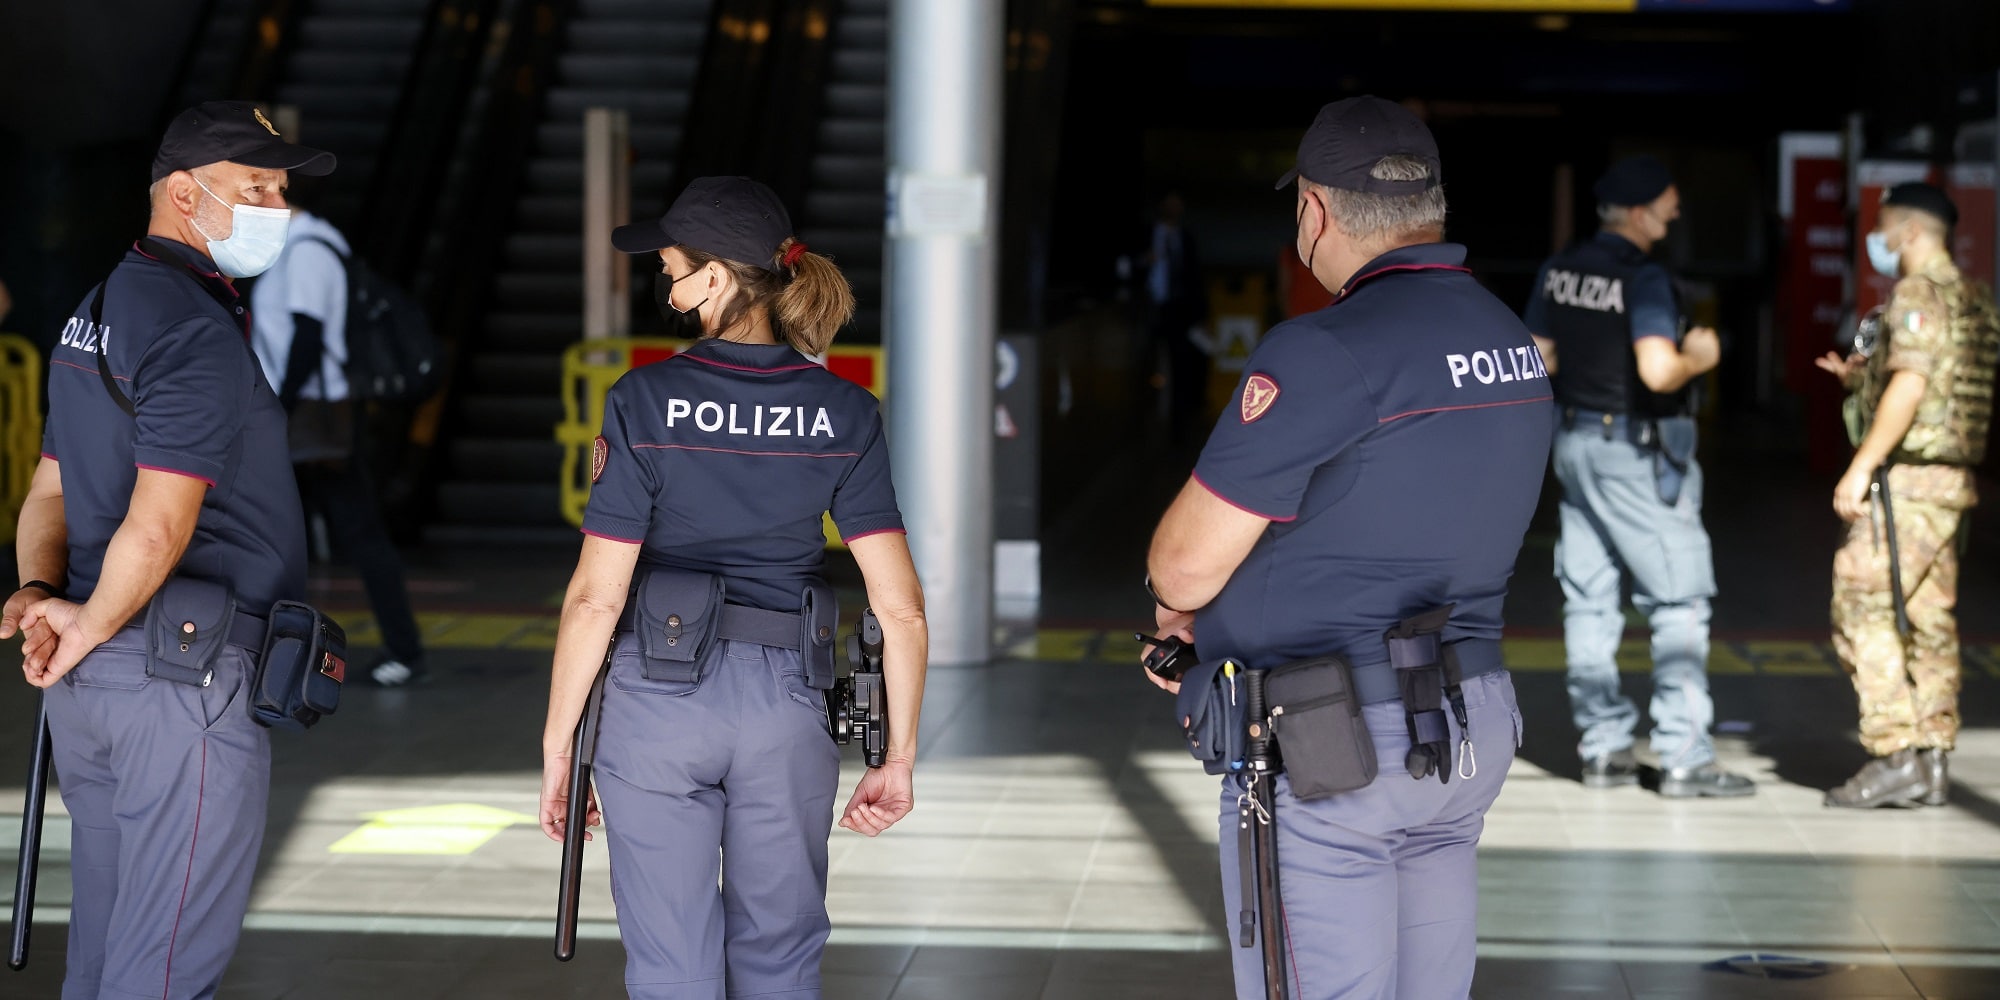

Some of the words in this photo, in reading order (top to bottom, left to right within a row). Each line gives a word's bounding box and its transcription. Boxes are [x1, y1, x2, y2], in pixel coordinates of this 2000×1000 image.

[1543, 268, 1625, 314] POLIZIA
[61, 316, 110, 355] OLIZA
[1446, 345, 1548, 388] POLIZIA
[666, 398, 835, 438] POLIZIA
